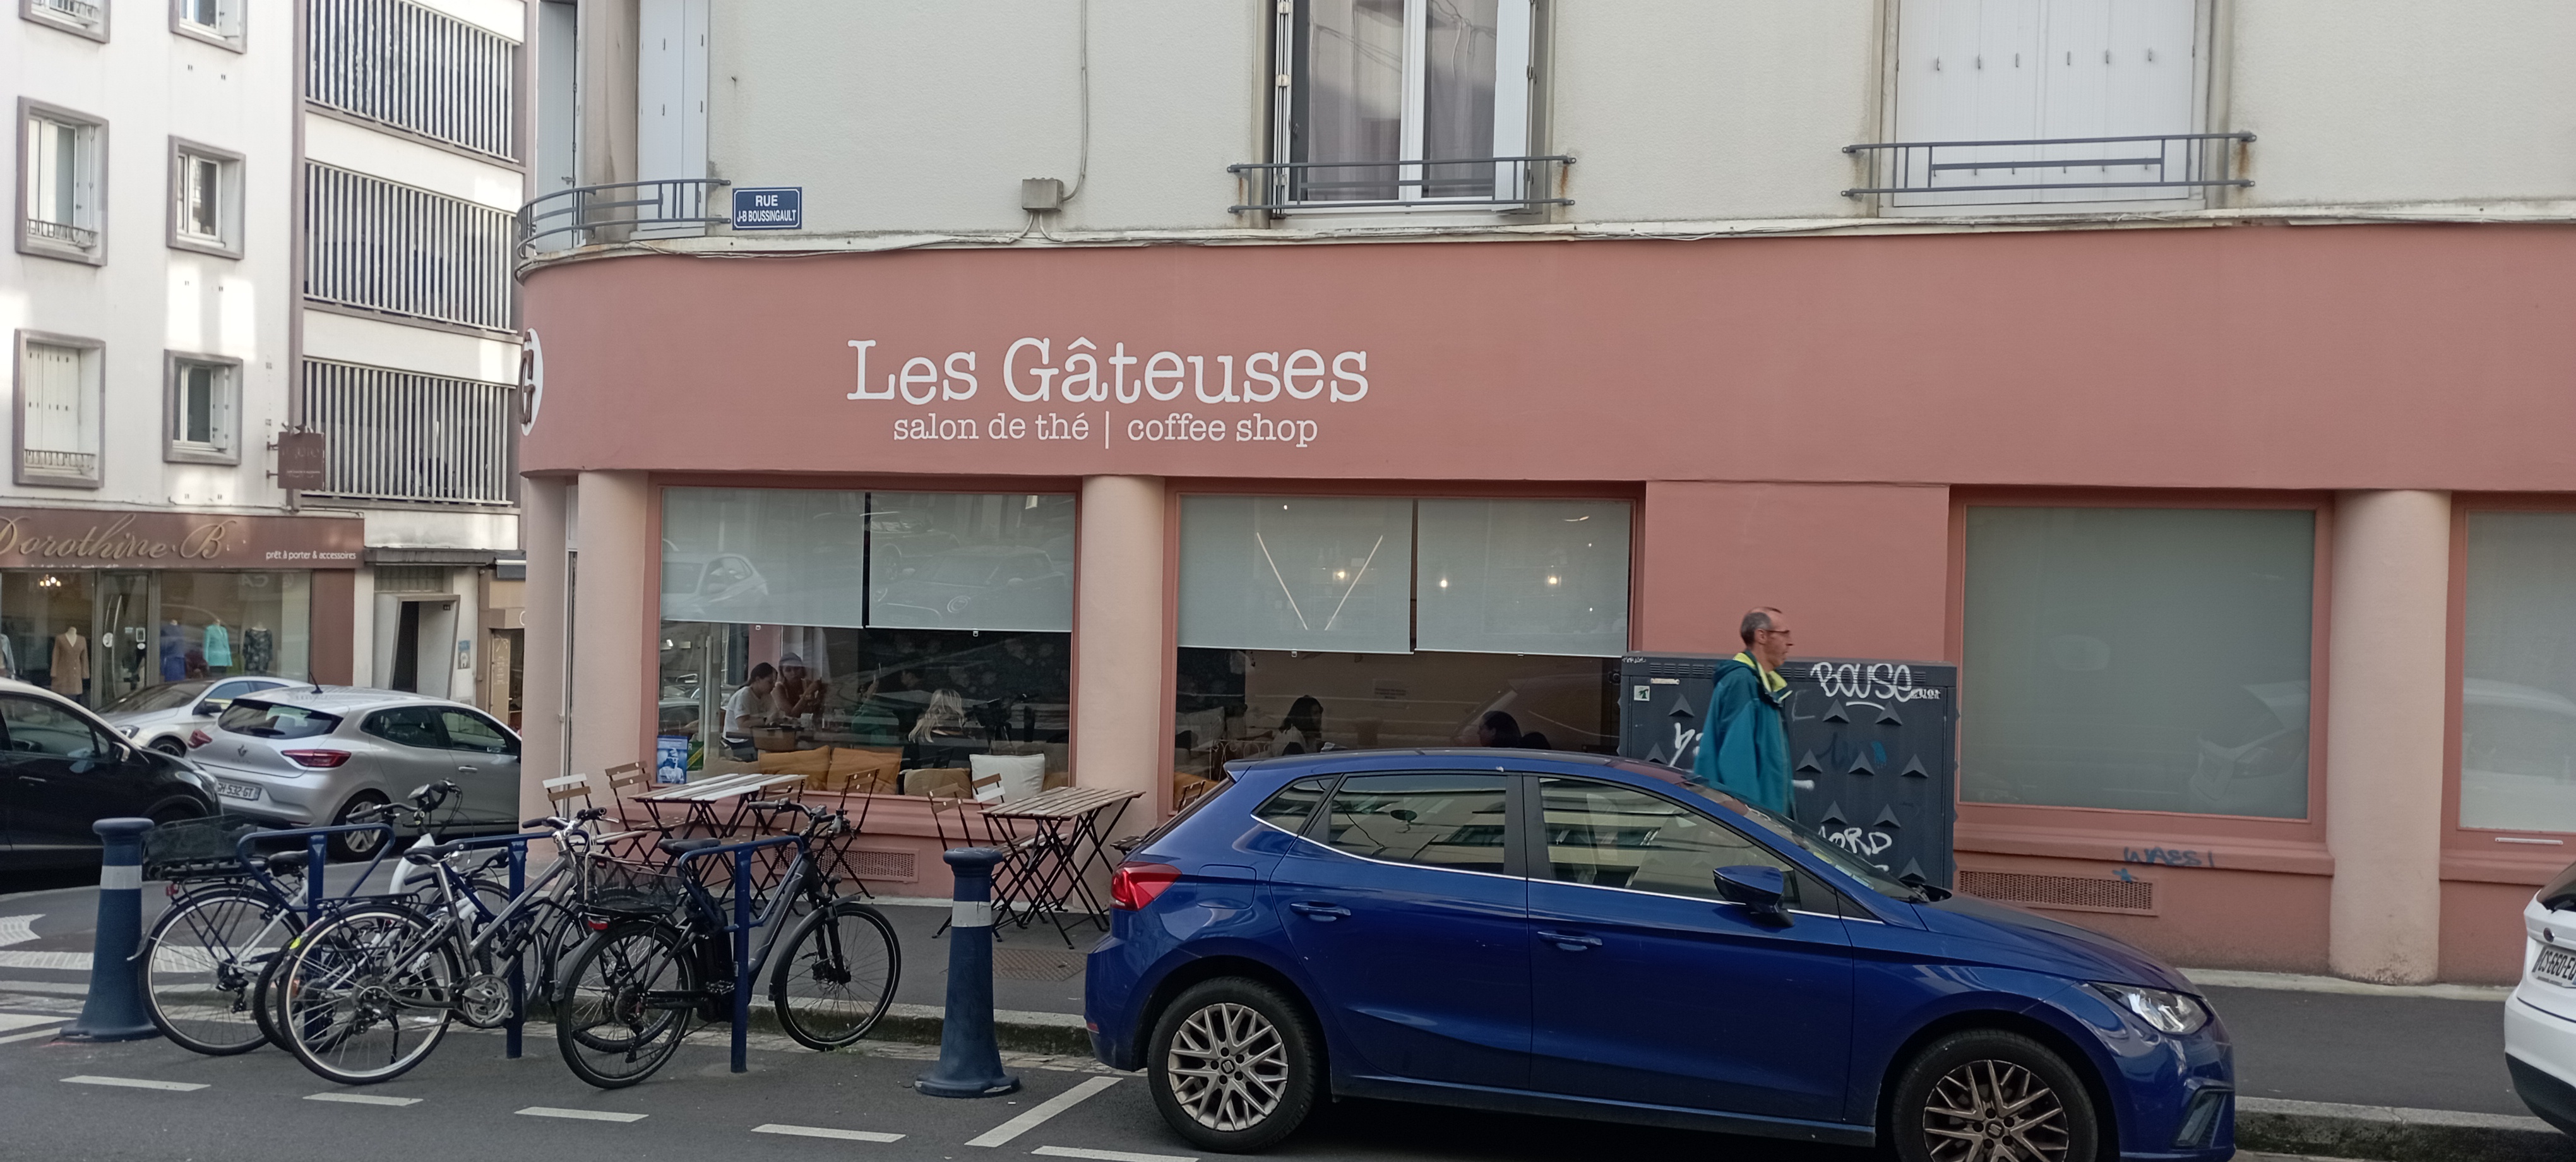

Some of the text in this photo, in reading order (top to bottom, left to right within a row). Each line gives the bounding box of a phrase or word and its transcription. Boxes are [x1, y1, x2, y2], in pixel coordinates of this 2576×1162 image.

[755, 195, 778, 207] RUE
[737, 209, 796, 222] J-B BOUSSINGAULT
[847, 336, 1368, 405] Les Gâteuses
[893, 412, 979, 440] salon
[988, 412, 1026, 440] de
[1035, 412, 1089, 440] thé
[1128, 412, 1226, 441] coffee
[1236, 413, 1318, 448] shop
[266, 550, 282, 560] prêt
[289, 552, 311, 560] porter
[313, 551, 317, 559] &
[319, 551, 356, 560] accessoires
